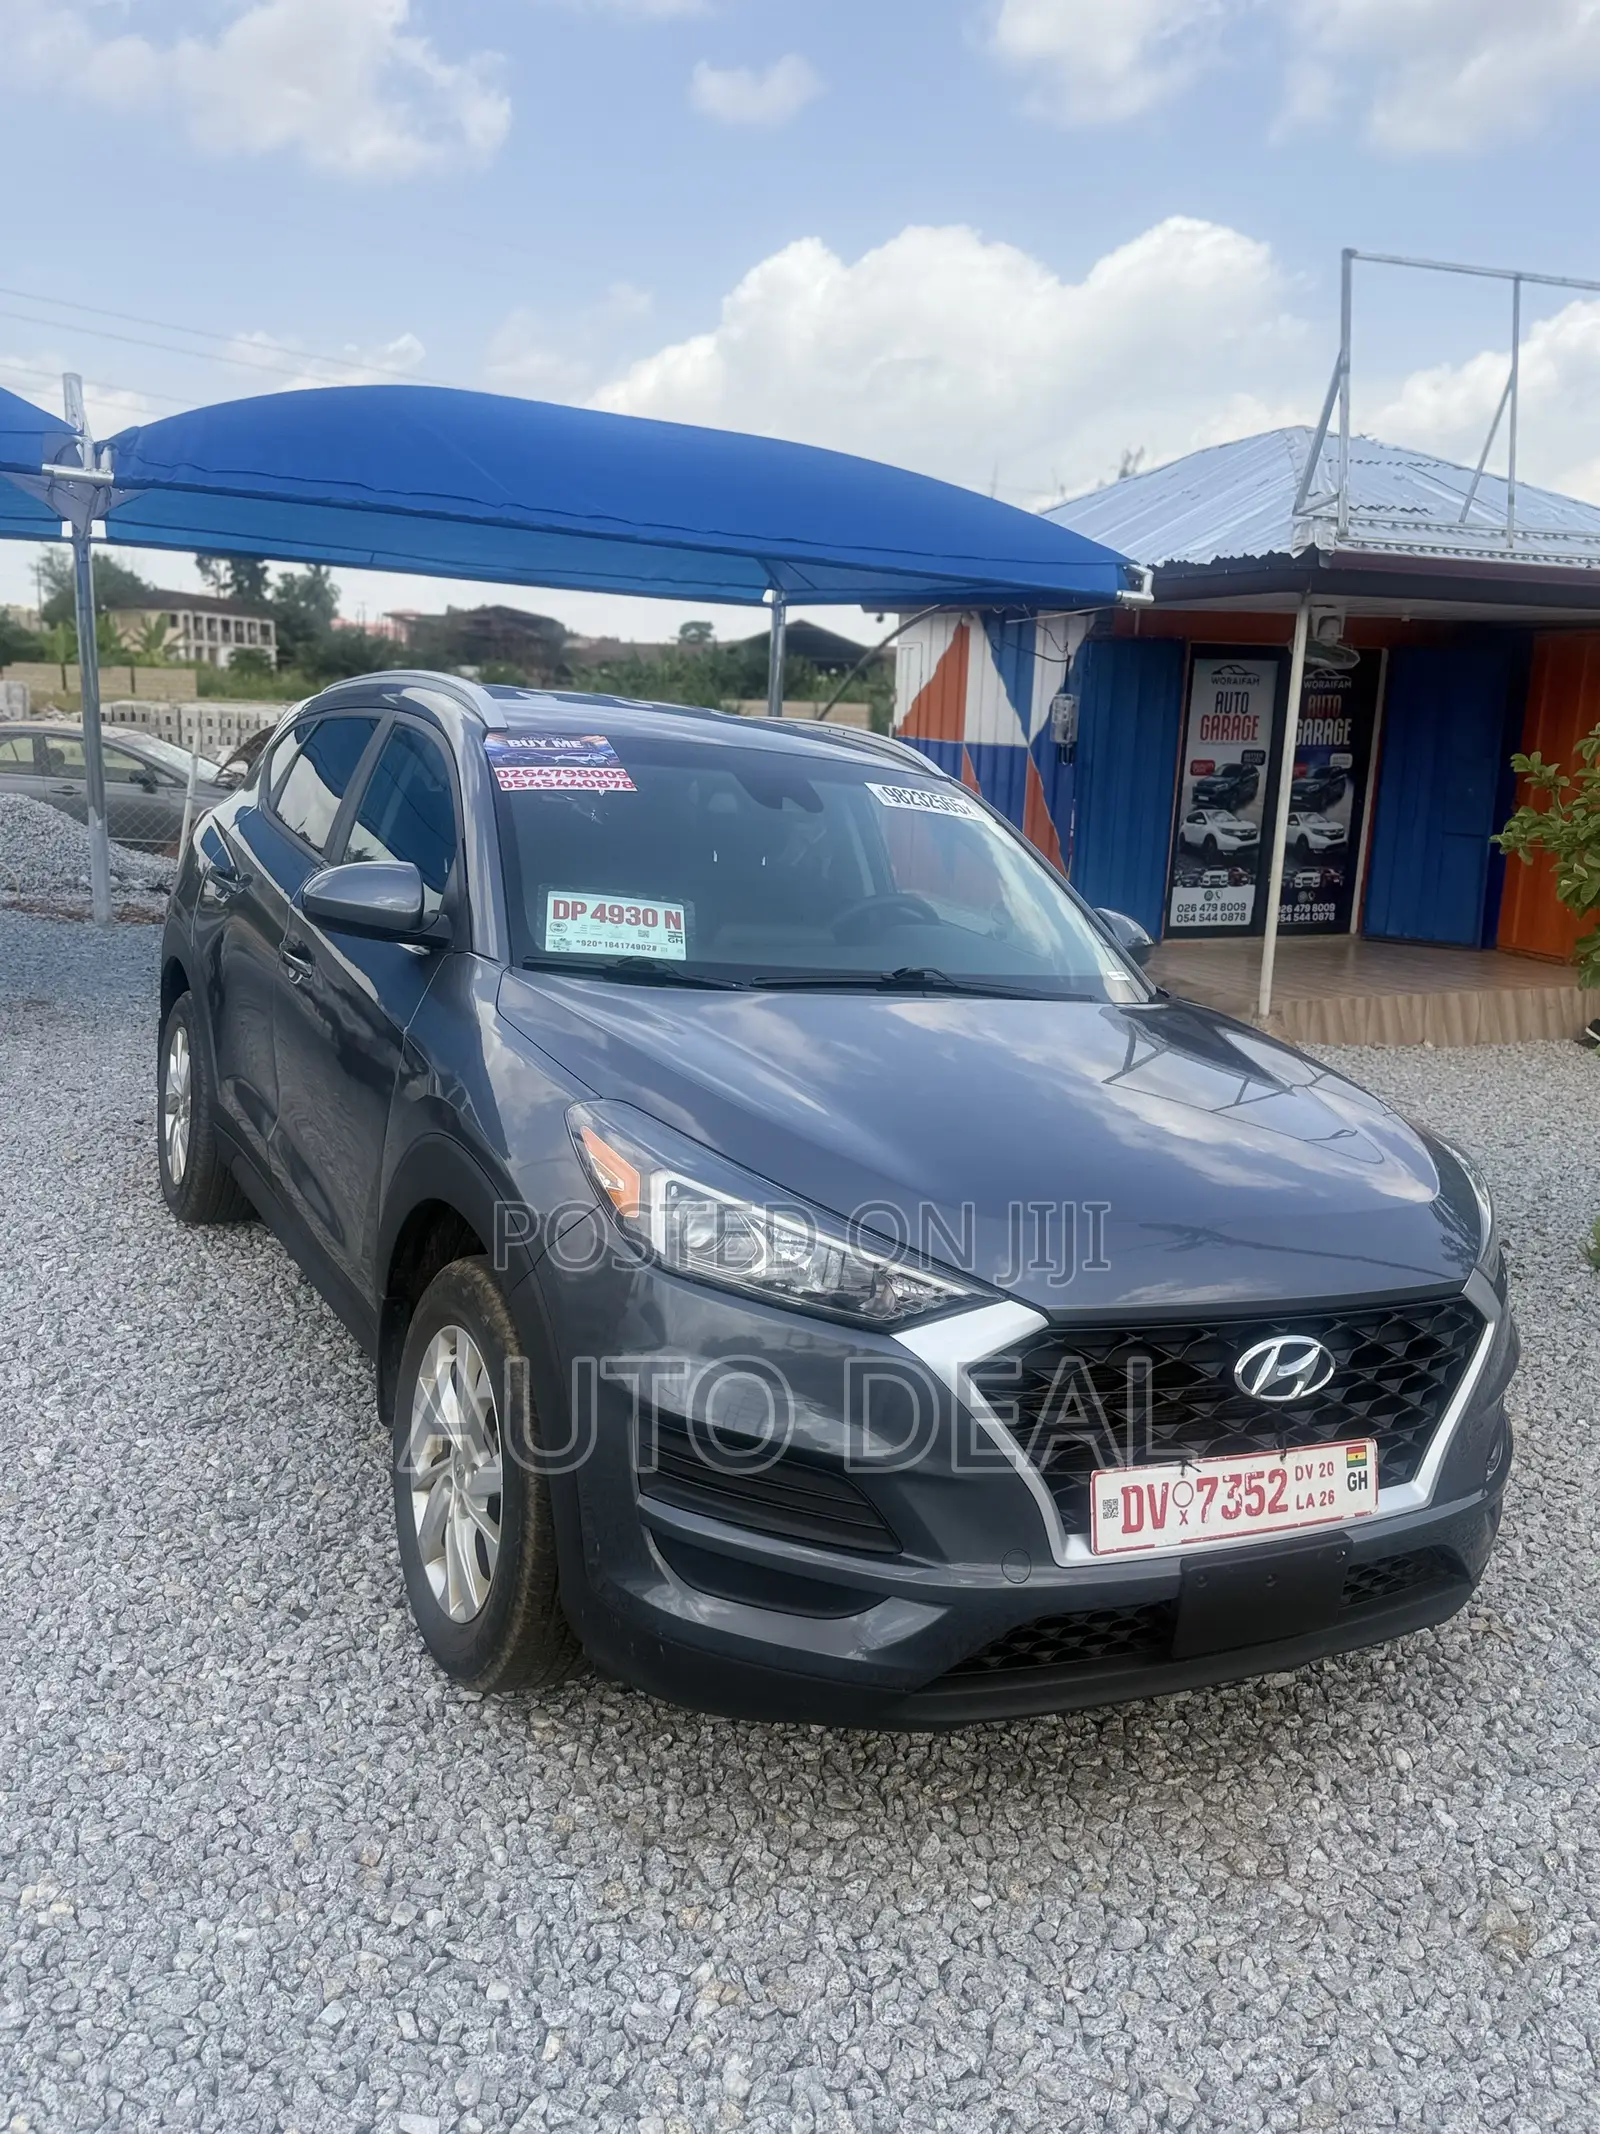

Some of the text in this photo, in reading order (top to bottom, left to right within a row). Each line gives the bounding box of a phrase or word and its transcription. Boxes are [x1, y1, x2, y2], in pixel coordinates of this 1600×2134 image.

[1211, 677, 1260, 686] WORAIFAM
[1303, 680, 1352, 689] WORAIFAM
[1215, 691, 1249, 714] AUTO
[1307, 694, 1342, 717] AUTO
[1200, 714, 1260, 741] GARAGE
[506, 739, 584, 749] BUY ME
[497, 769, 629, 779] 0264798009
[501, 779, 635, 789] 0545440878
[1177, 902, 1247, 913] 026 479 8009
[1294, 904, 1310, 913] 479
[553, 899, 682, 930] DP 4930 N
[1176, 912, 1246, 923] 054 544 0878
[1293, 913, 1310, 922] 544
[1295, 1461, 1334, 1481] DV 20
[1347, 1471, 1368, 1492] GH
[1121, 1468, 1288, 1534] DV 7352
[1296, 1490, 1335, 1510] LA 26
